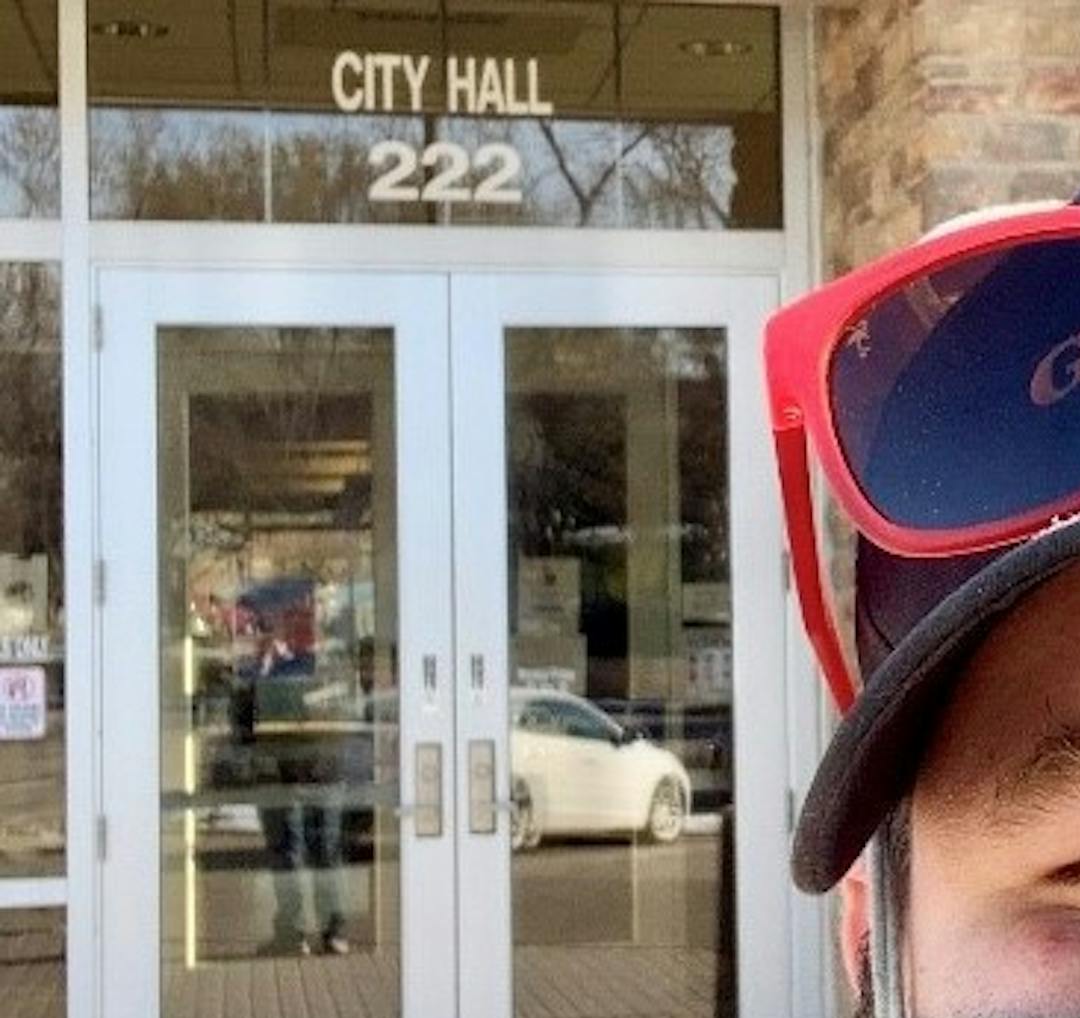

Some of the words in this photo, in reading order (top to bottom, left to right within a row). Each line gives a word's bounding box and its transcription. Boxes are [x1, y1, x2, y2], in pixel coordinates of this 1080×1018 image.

[332, 50, 430, 112] CITY
[447, 57, 554, 116] HALL
[368, 140, 523, 202] 222
